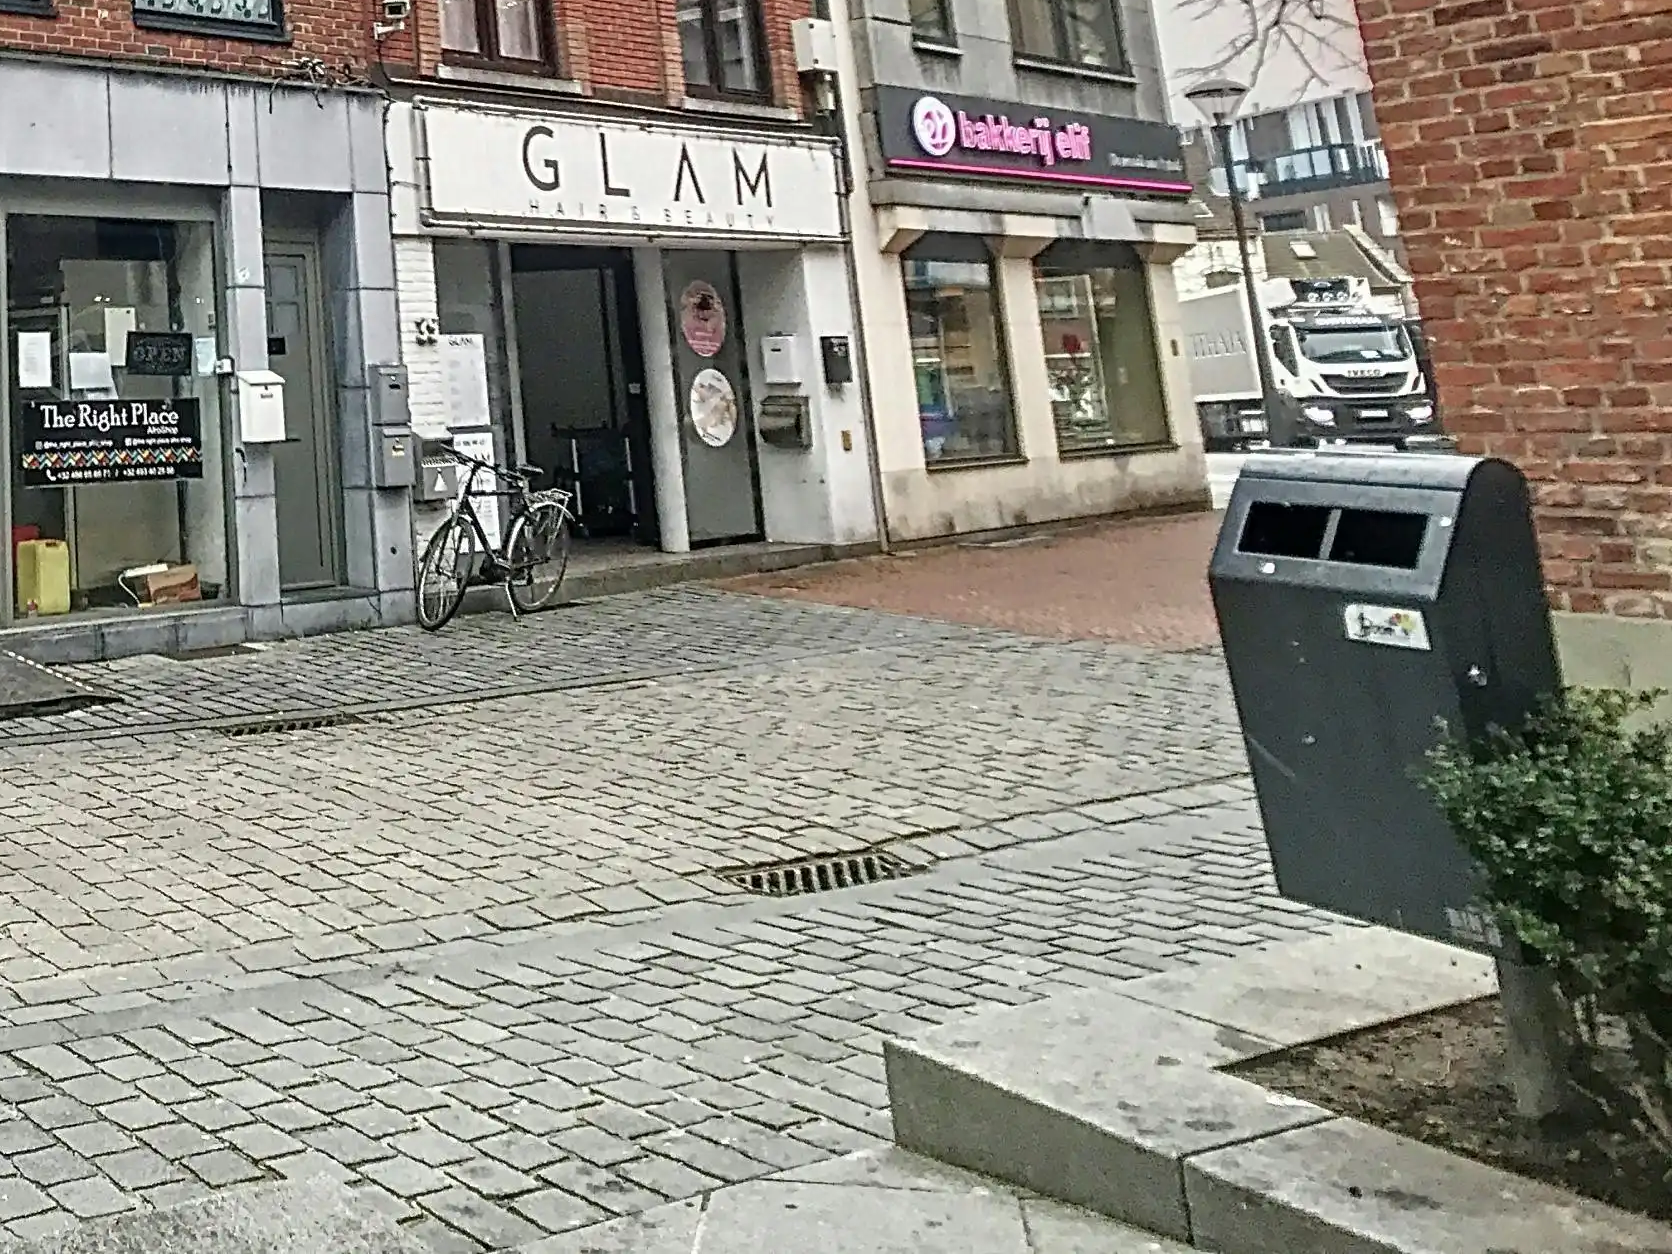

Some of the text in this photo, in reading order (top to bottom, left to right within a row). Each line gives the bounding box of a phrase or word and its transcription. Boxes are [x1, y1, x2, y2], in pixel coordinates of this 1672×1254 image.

[956, 110, 1092, 166] bakkerij elif
[522, 125, 773, 208] GLAM
[528, 199, 609, 220] HAIR
[663, 208, 776, 229] BEAUTY
[1347, 369, 1382, 377] IVECO
[39, 401, 180, 433] The Right Place
